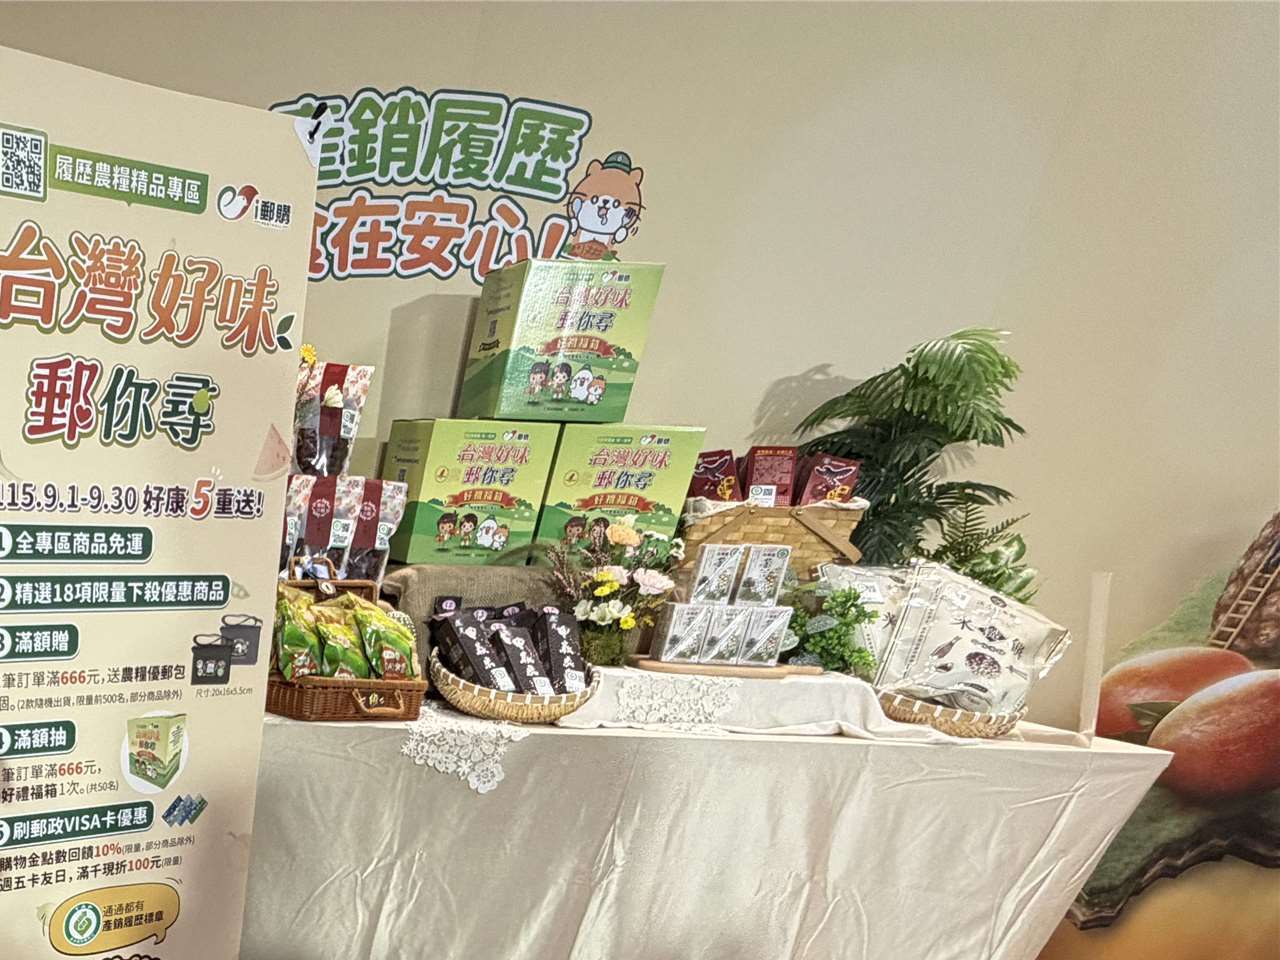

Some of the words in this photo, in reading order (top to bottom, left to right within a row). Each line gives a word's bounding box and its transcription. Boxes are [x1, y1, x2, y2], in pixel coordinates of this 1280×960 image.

[54, 155, 201, 204] 履歷農糧精品專區
[25, 357, 218, 446] 郵你尋
[457, 444, 530, 465] 台灣好味
[590, 448, 672, 470] 台灣好味
[142, 479, 265, 519] 好康5重送!
[16, 531, 145, 555] 全專區商品免運
[15, 580, 224, 606] 精選18項限量下殺優惠商品
[15, 630, 70, 653] 滿額贈
[14, 726, 67, 750] 滿額抽
[13, 805, 149, 841] 刷郵政VISA卡優惠
